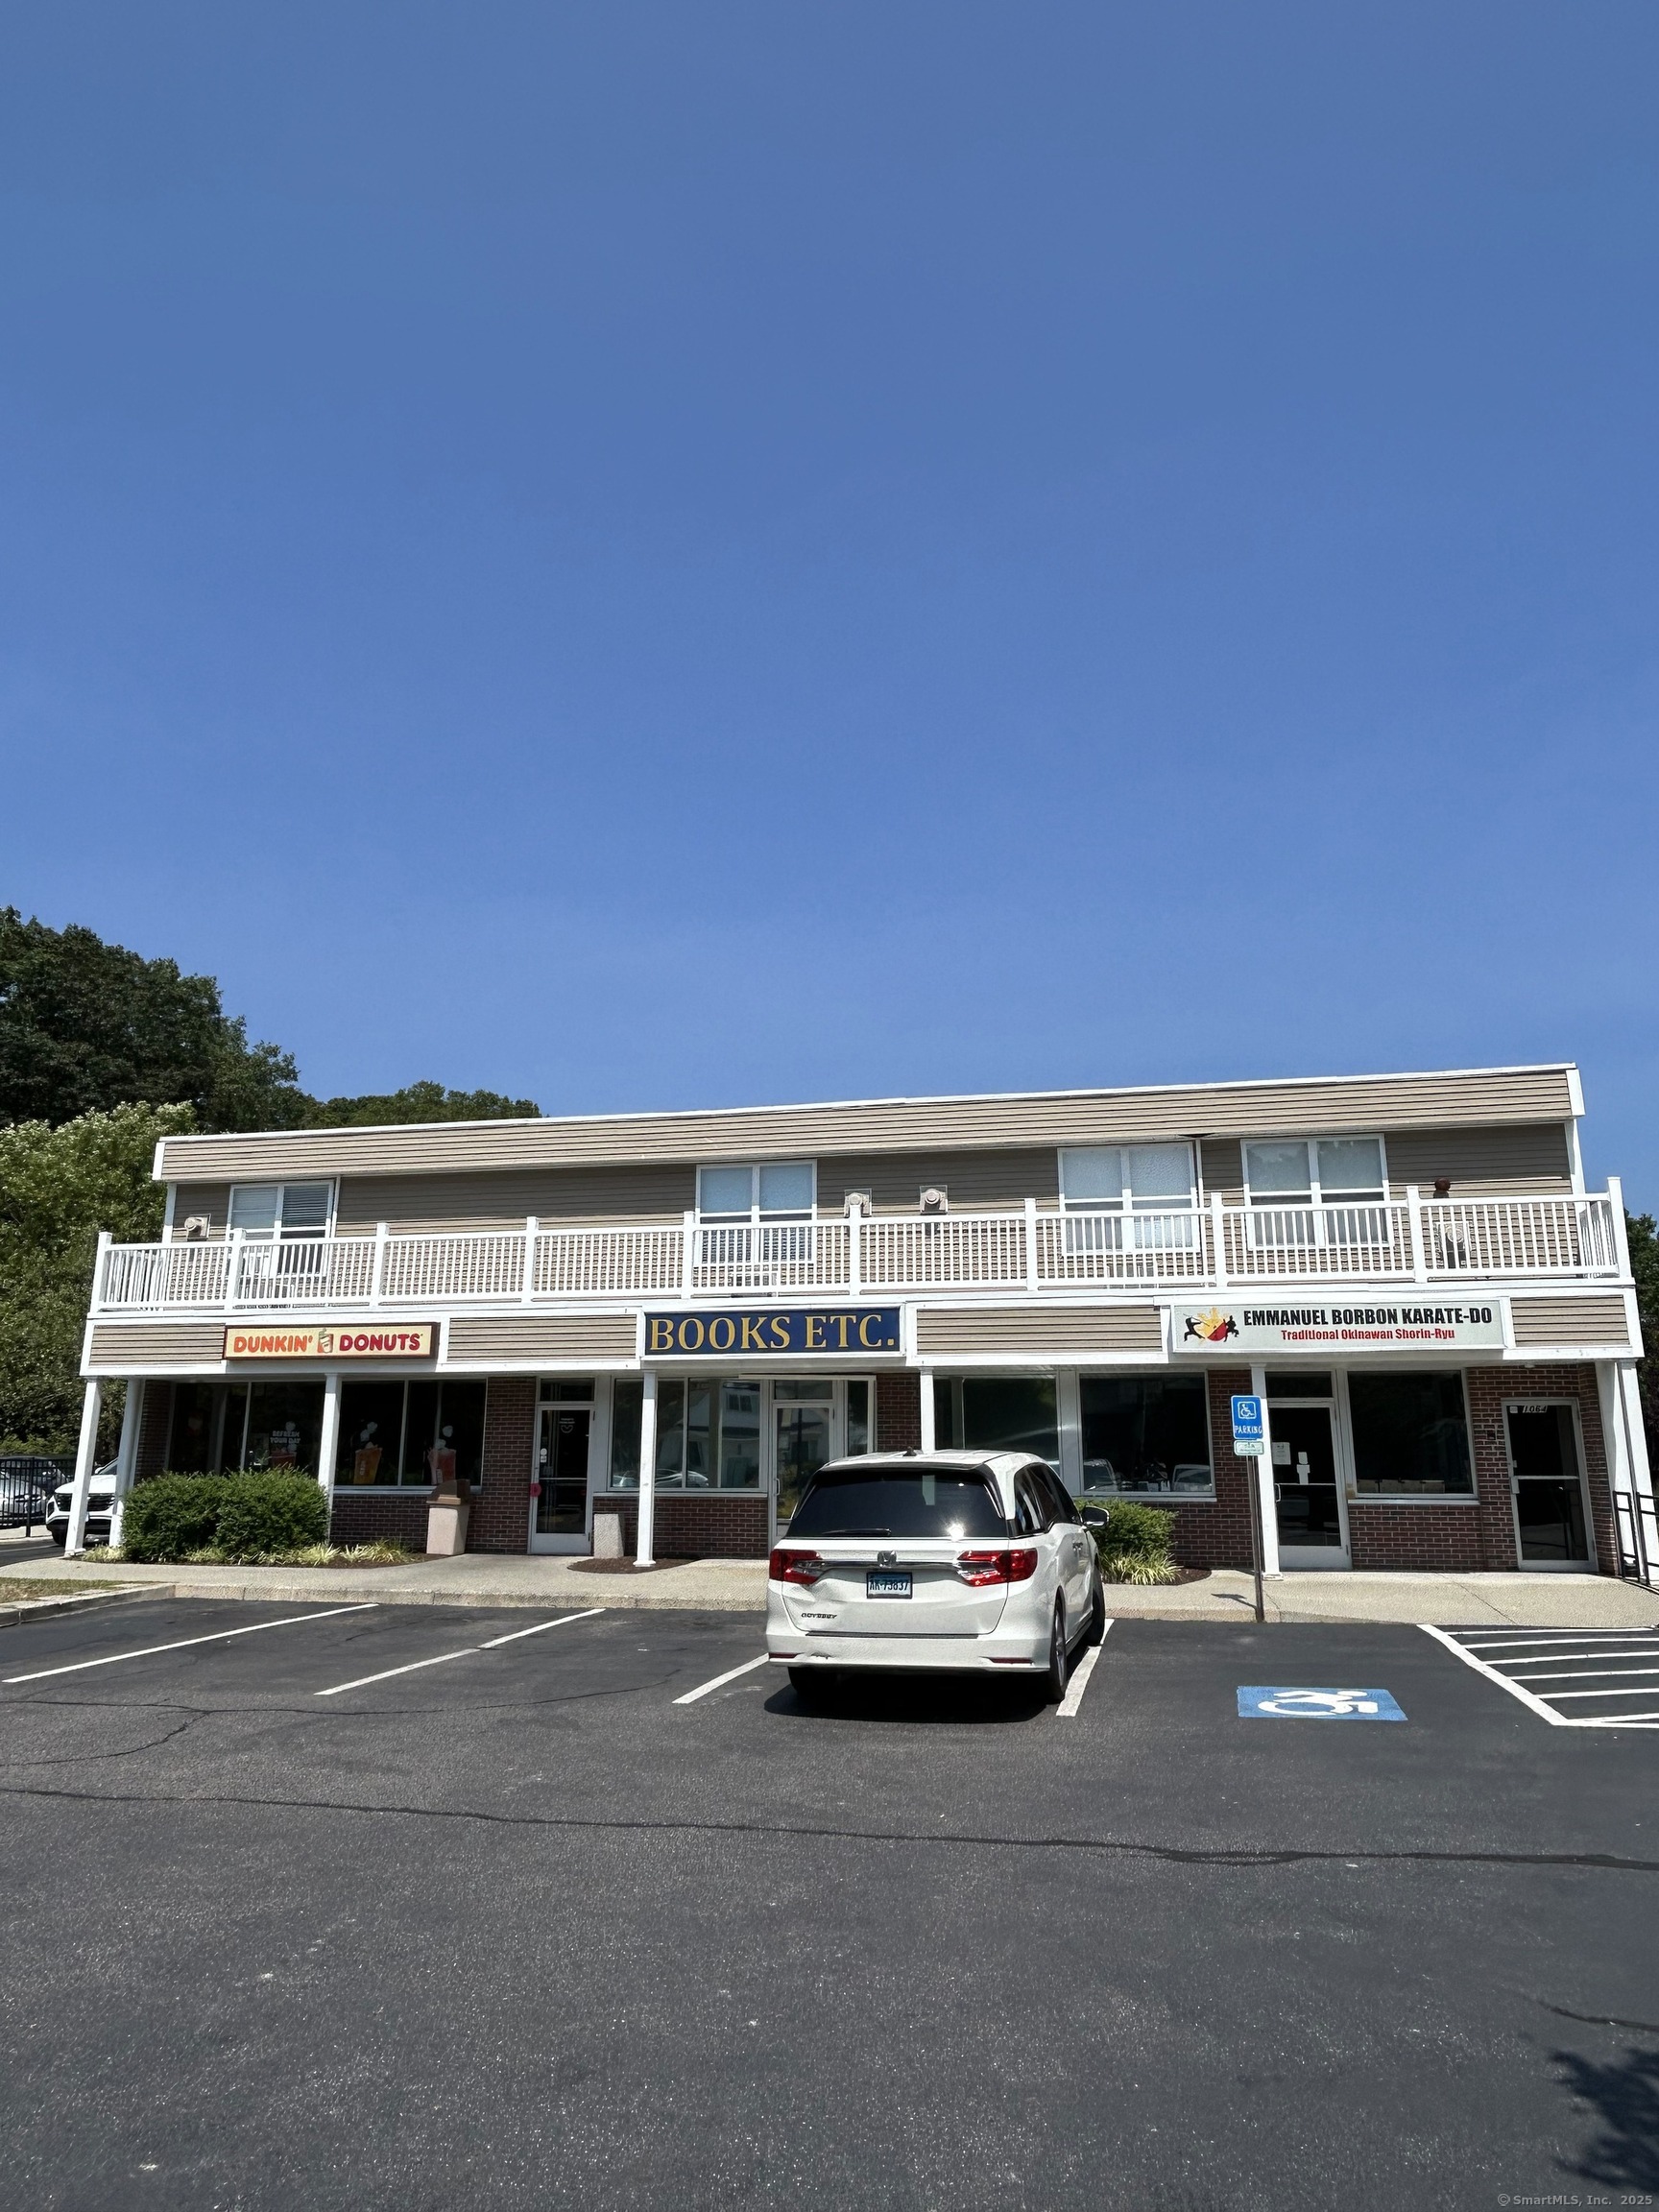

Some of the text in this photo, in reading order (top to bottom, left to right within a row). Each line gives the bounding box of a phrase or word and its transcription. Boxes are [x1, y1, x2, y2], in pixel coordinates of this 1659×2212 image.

[1243, 1308, 1492, 1326] EMMANUEL BORBON KARATE-DO
[650, 1314, 895, 1350] BOOKS ETC.
[1281, 1328, 1455, 1340] Traditional Okinawan Shorin-Ryu
[233, 1333, 421, 1353] DUNKIN' DONUTS
[1234, 1425, 1262, 1434] PARKING
